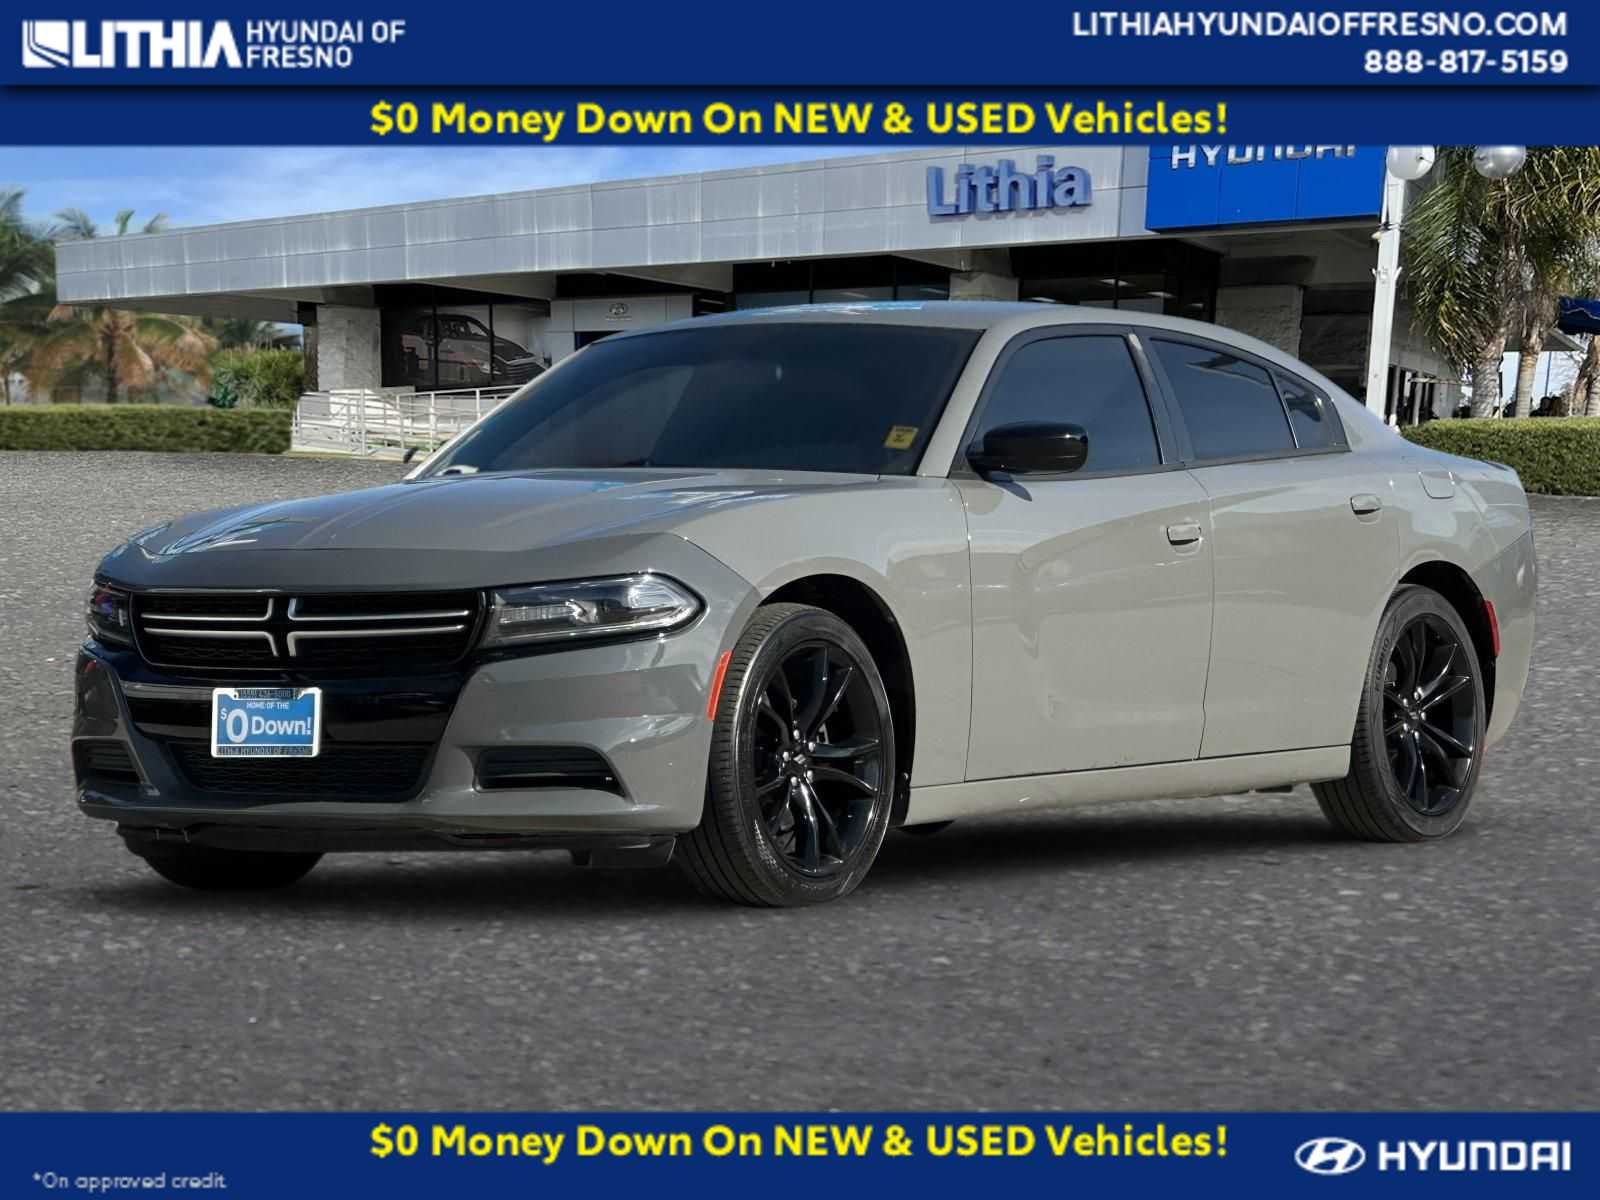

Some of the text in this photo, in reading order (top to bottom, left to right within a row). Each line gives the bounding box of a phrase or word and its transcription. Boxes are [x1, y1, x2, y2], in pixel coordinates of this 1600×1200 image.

[927, 155, 1092, 217] Lithia
[276, 701, 290, 710] THE
[219, 707, 313, 744] $0 Down!
